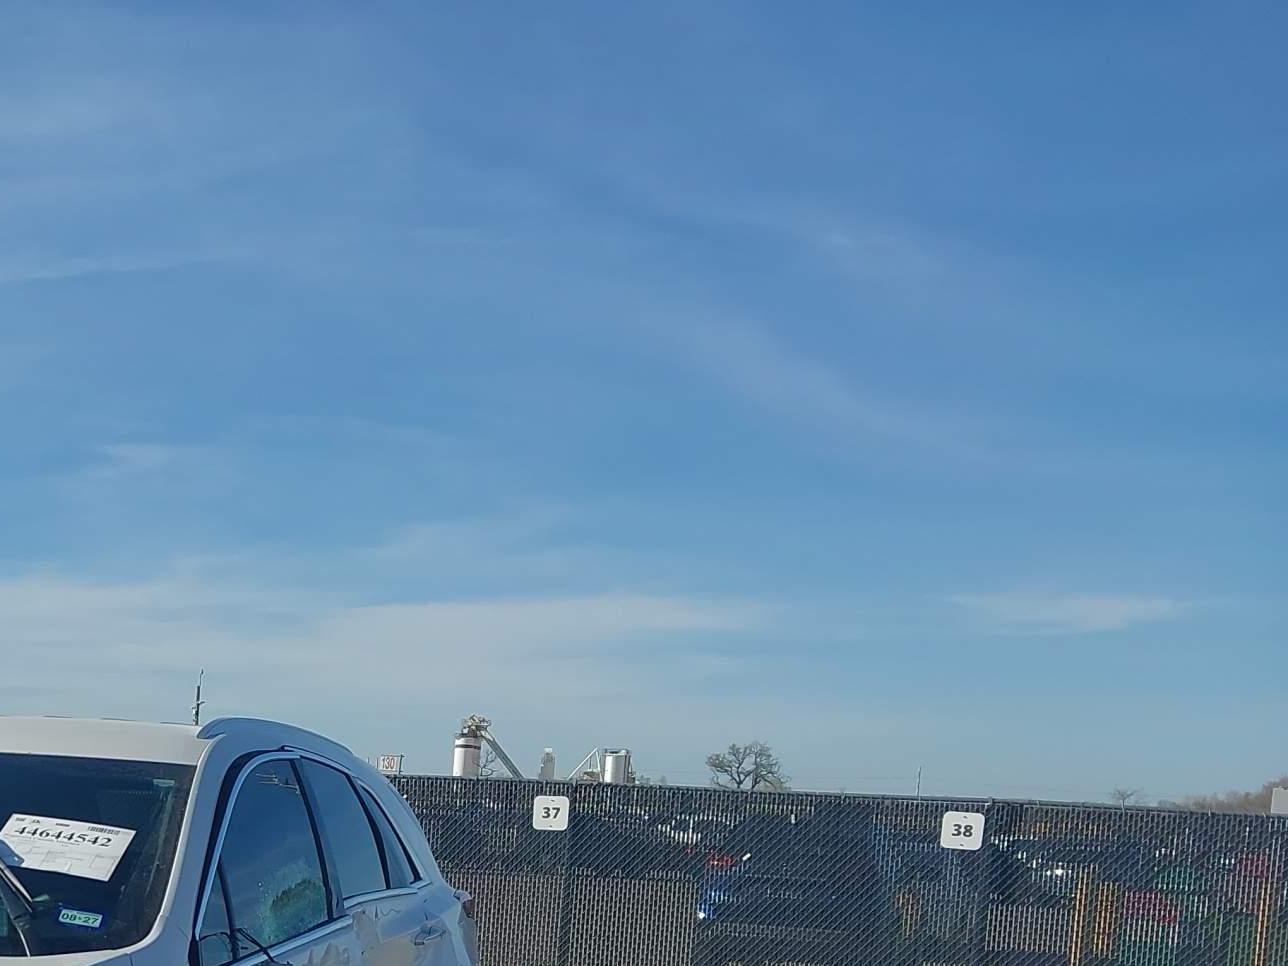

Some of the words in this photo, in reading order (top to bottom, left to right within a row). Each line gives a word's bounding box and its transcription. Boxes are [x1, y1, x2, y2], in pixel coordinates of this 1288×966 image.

[381, 757, 396, 770] 130
[541, 806, 561, 819] 37
[14, 825, 113, 848] 44644542
[951, 823, 974, 838] 38
